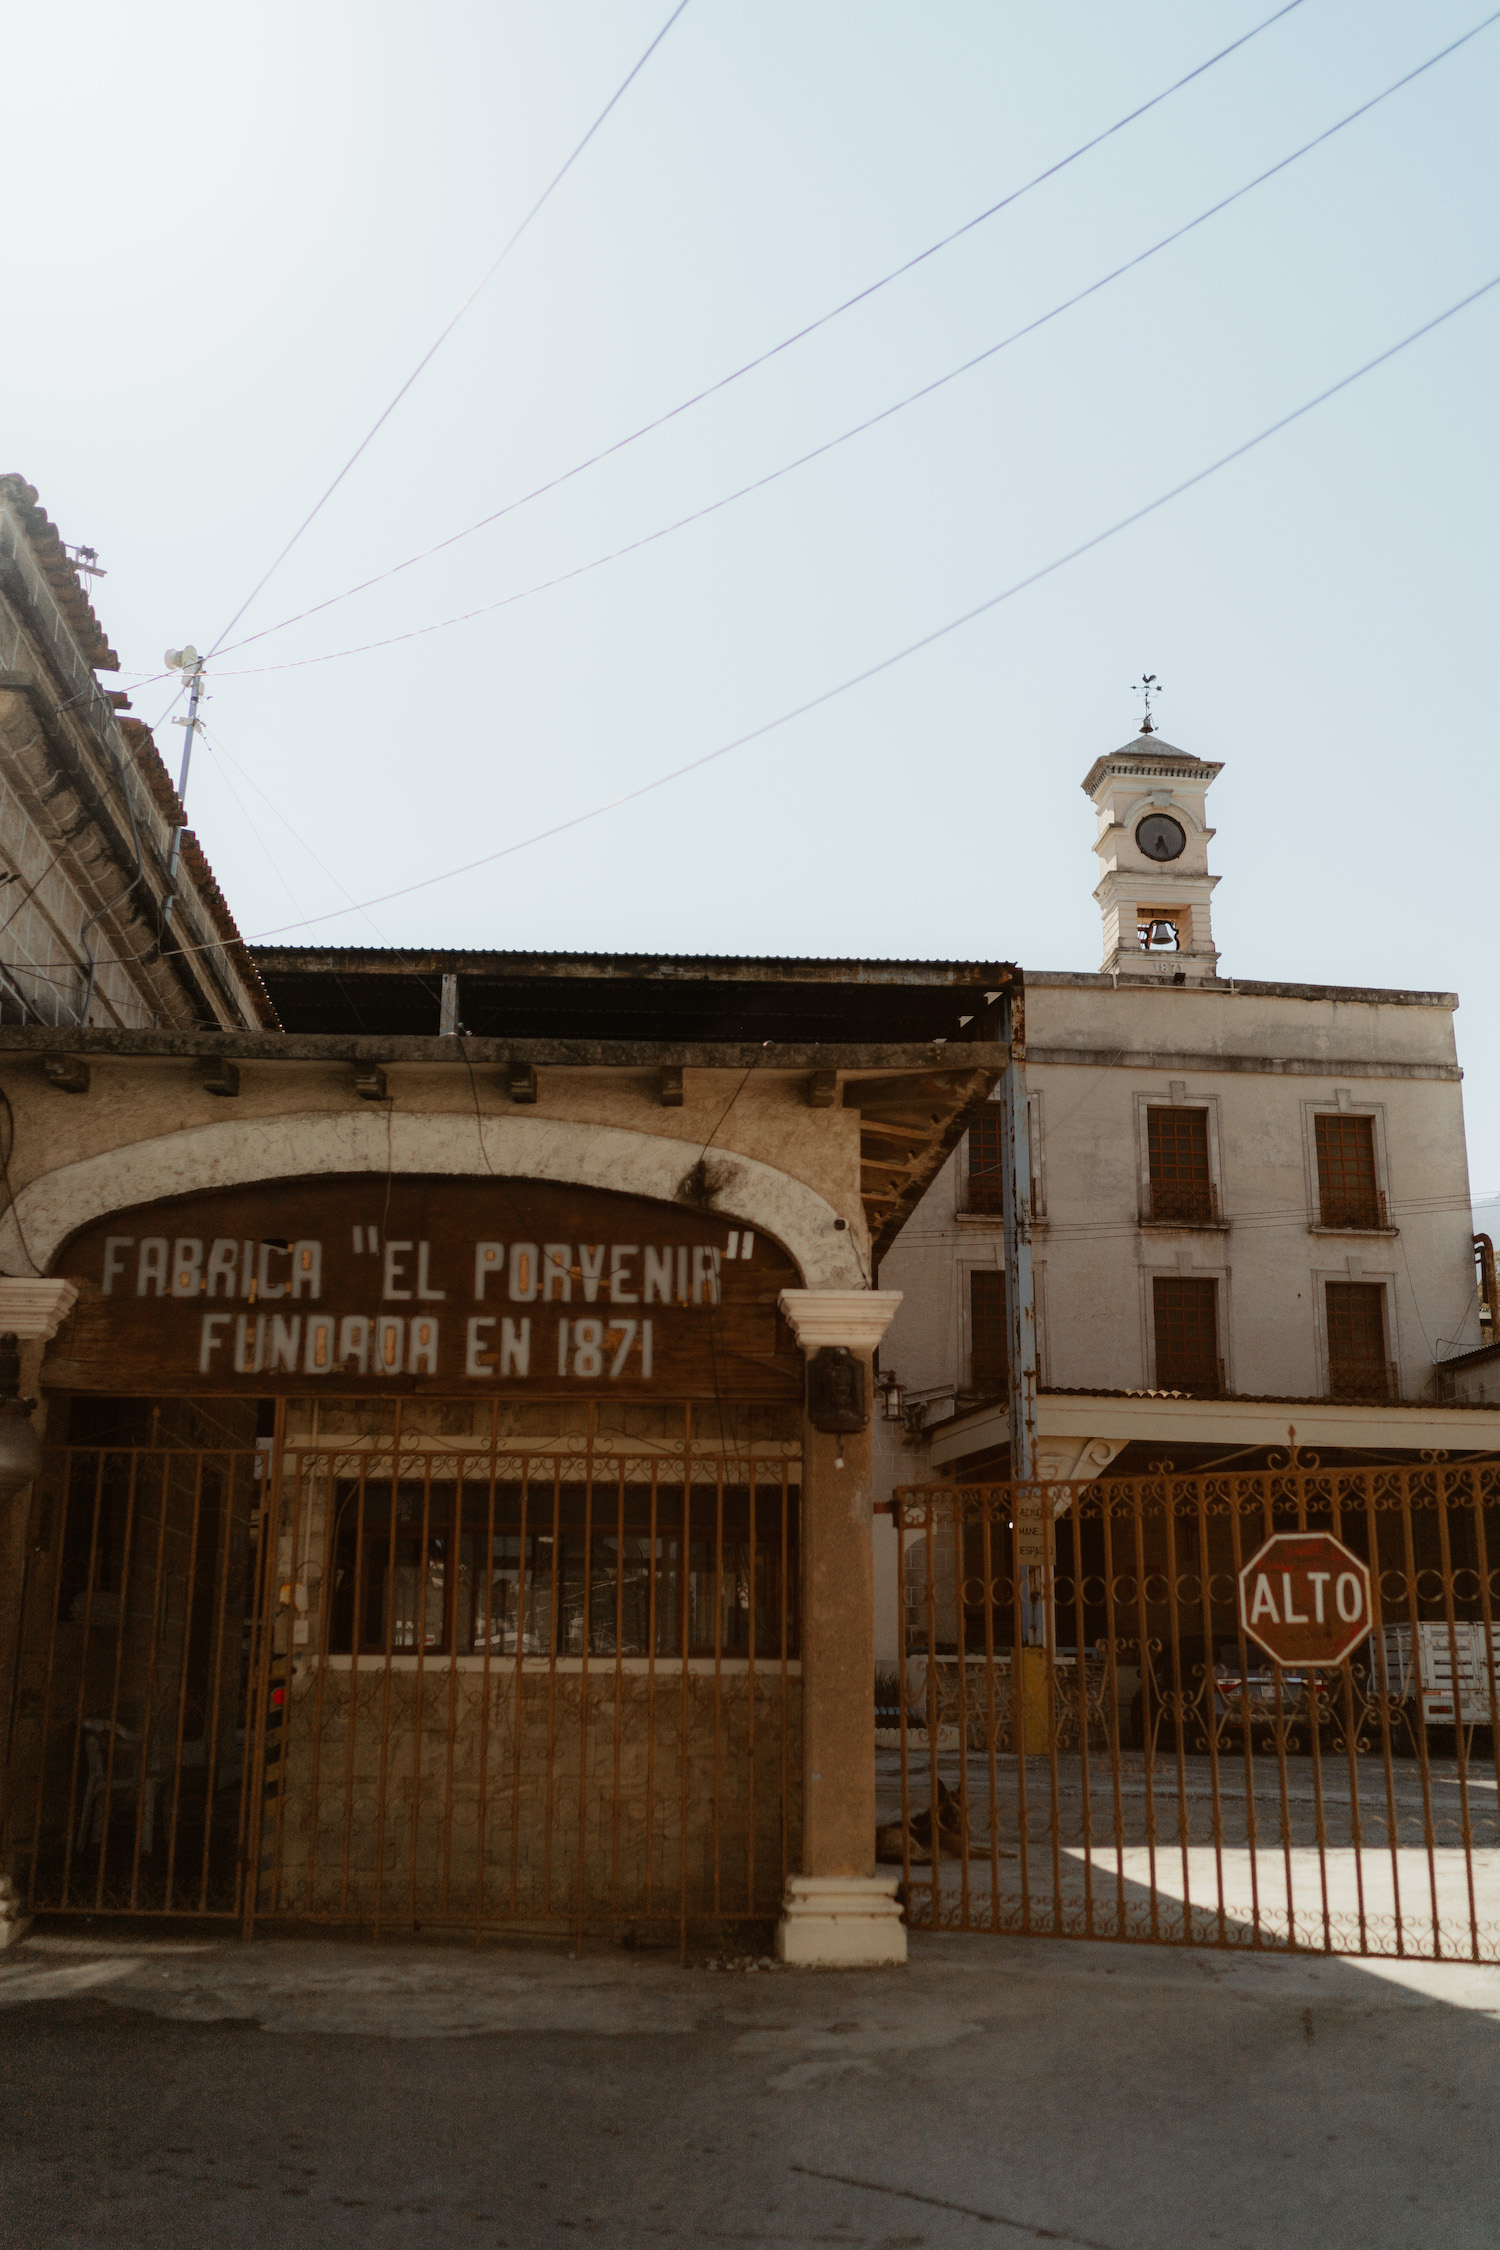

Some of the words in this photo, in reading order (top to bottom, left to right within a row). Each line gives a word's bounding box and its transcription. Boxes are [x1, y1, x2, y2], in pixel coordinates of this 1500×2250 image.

[1154, 961, 1184, 973] 1871
[102, 1235, 323, 1299] FABRICA
[198, 1313, 439, 1375] FUNDADA
[465, 1316, 531, 1378] EN
[557, 1317, 653, 1379] 1871
[1018, 1527, 1044, 1536] MANE
[1251, 1572, 1362, 1624] ALTO
